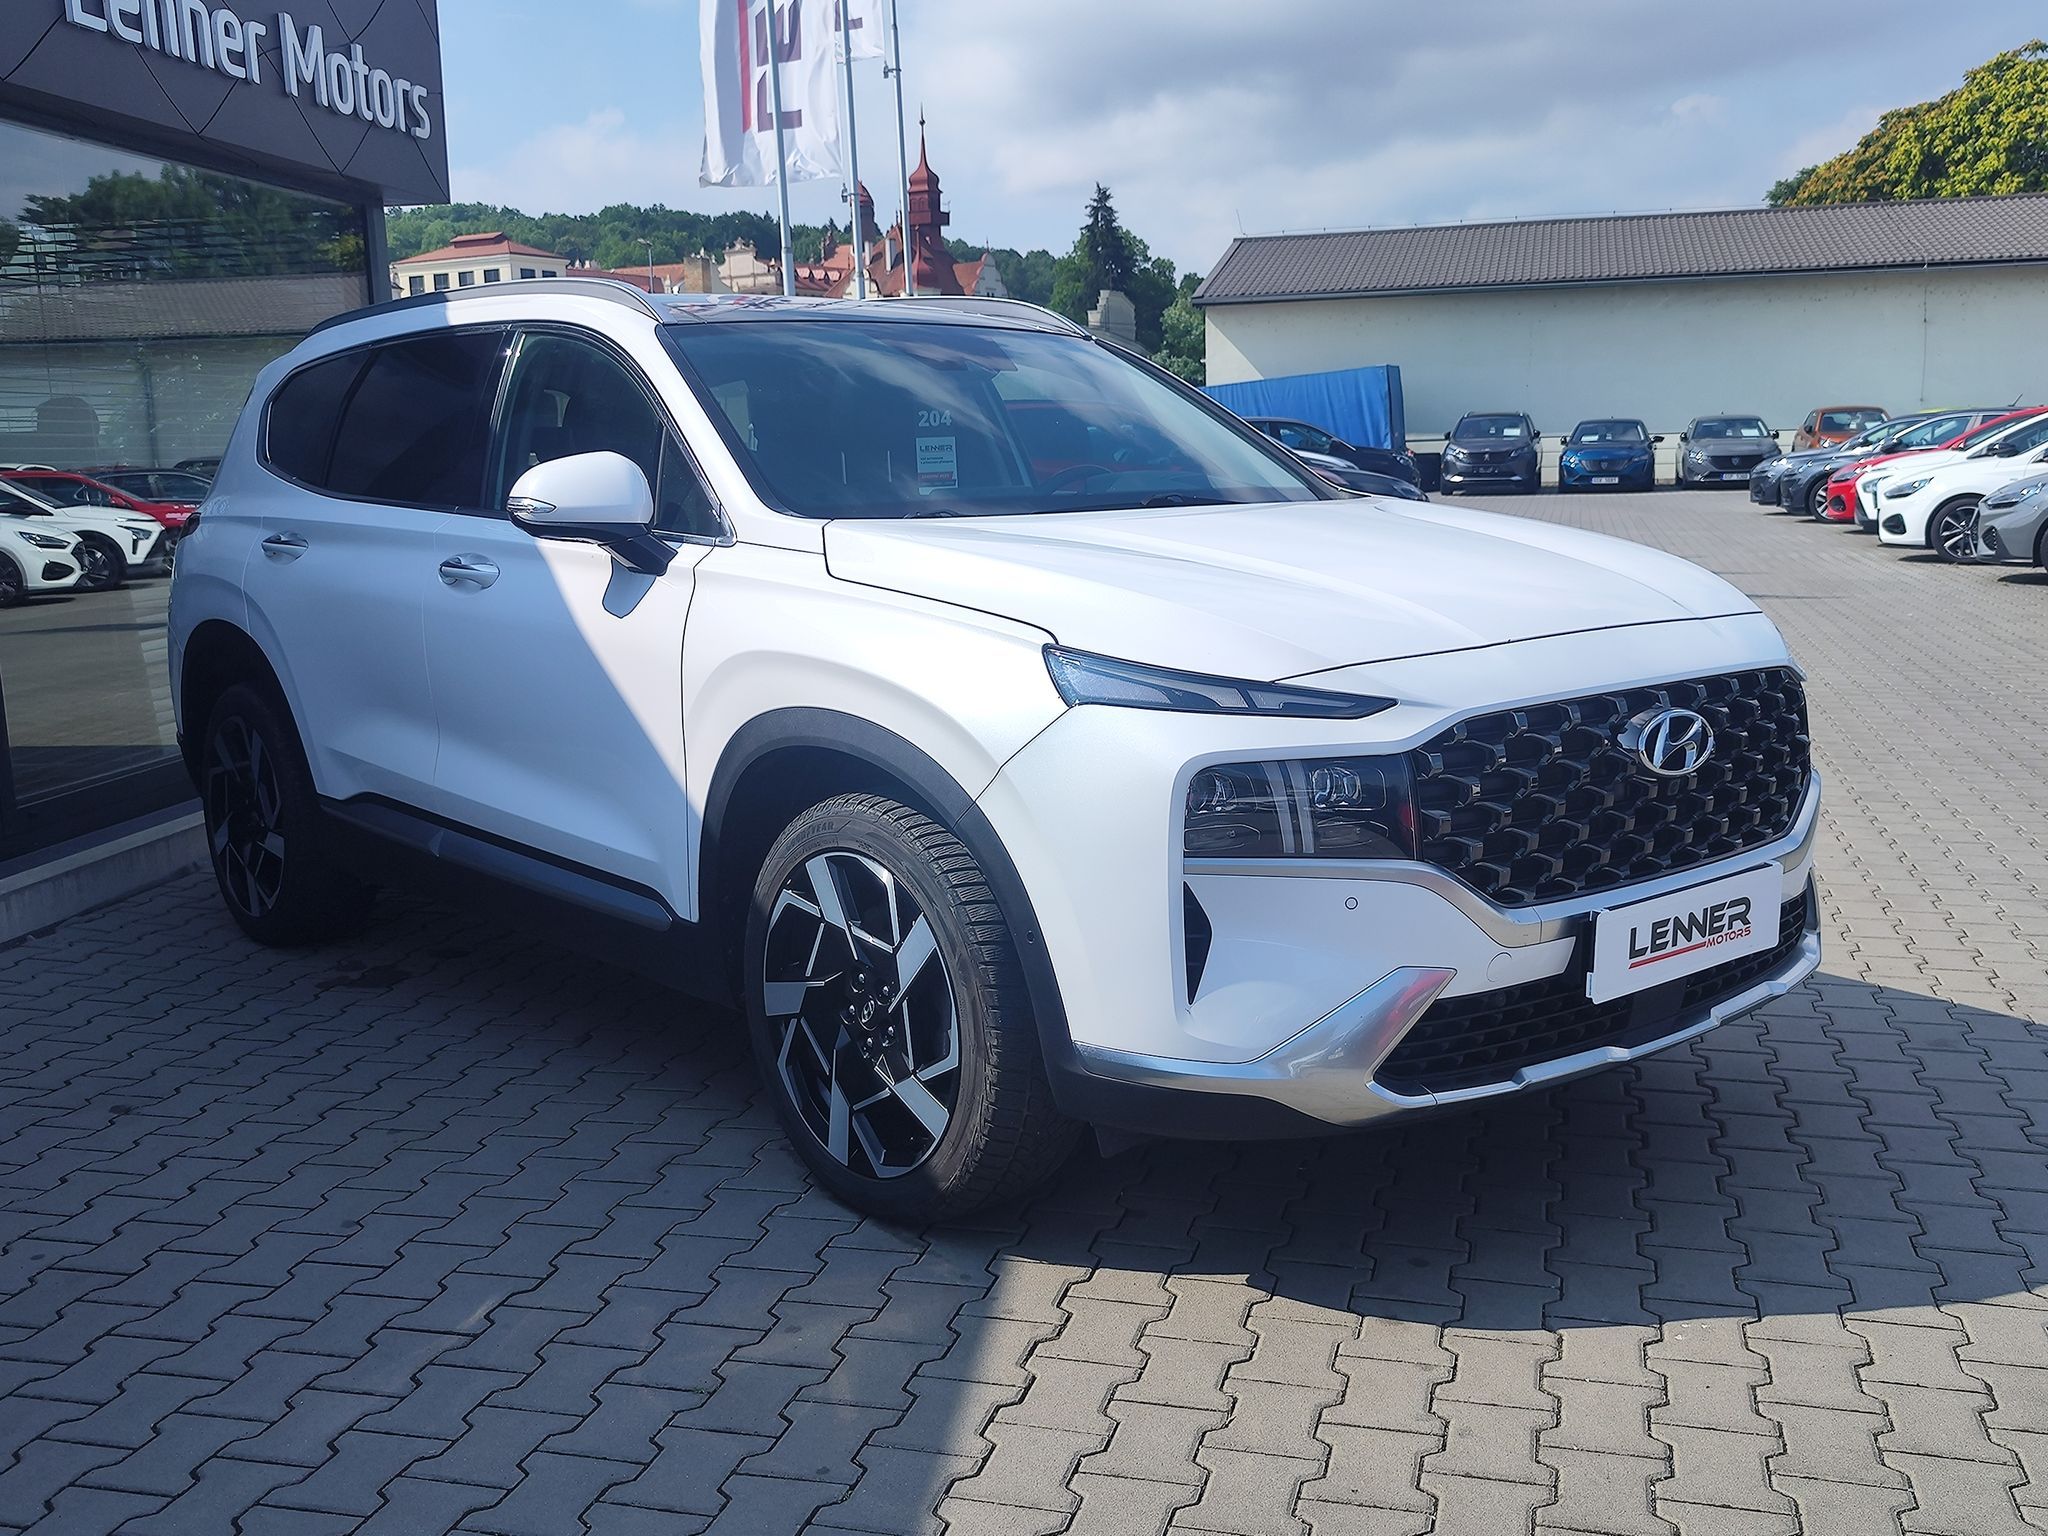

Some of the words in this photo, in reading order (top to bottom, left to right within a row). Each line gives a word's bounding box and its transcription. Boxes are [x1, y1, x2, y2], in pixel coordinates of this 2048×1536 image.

[278, 12, 431, 139] Motors
[918, 409, 952, 427] 204
[1628, 896, 1752, 960] LENNER
[1705, 925, 1752, 948] MOTORS
